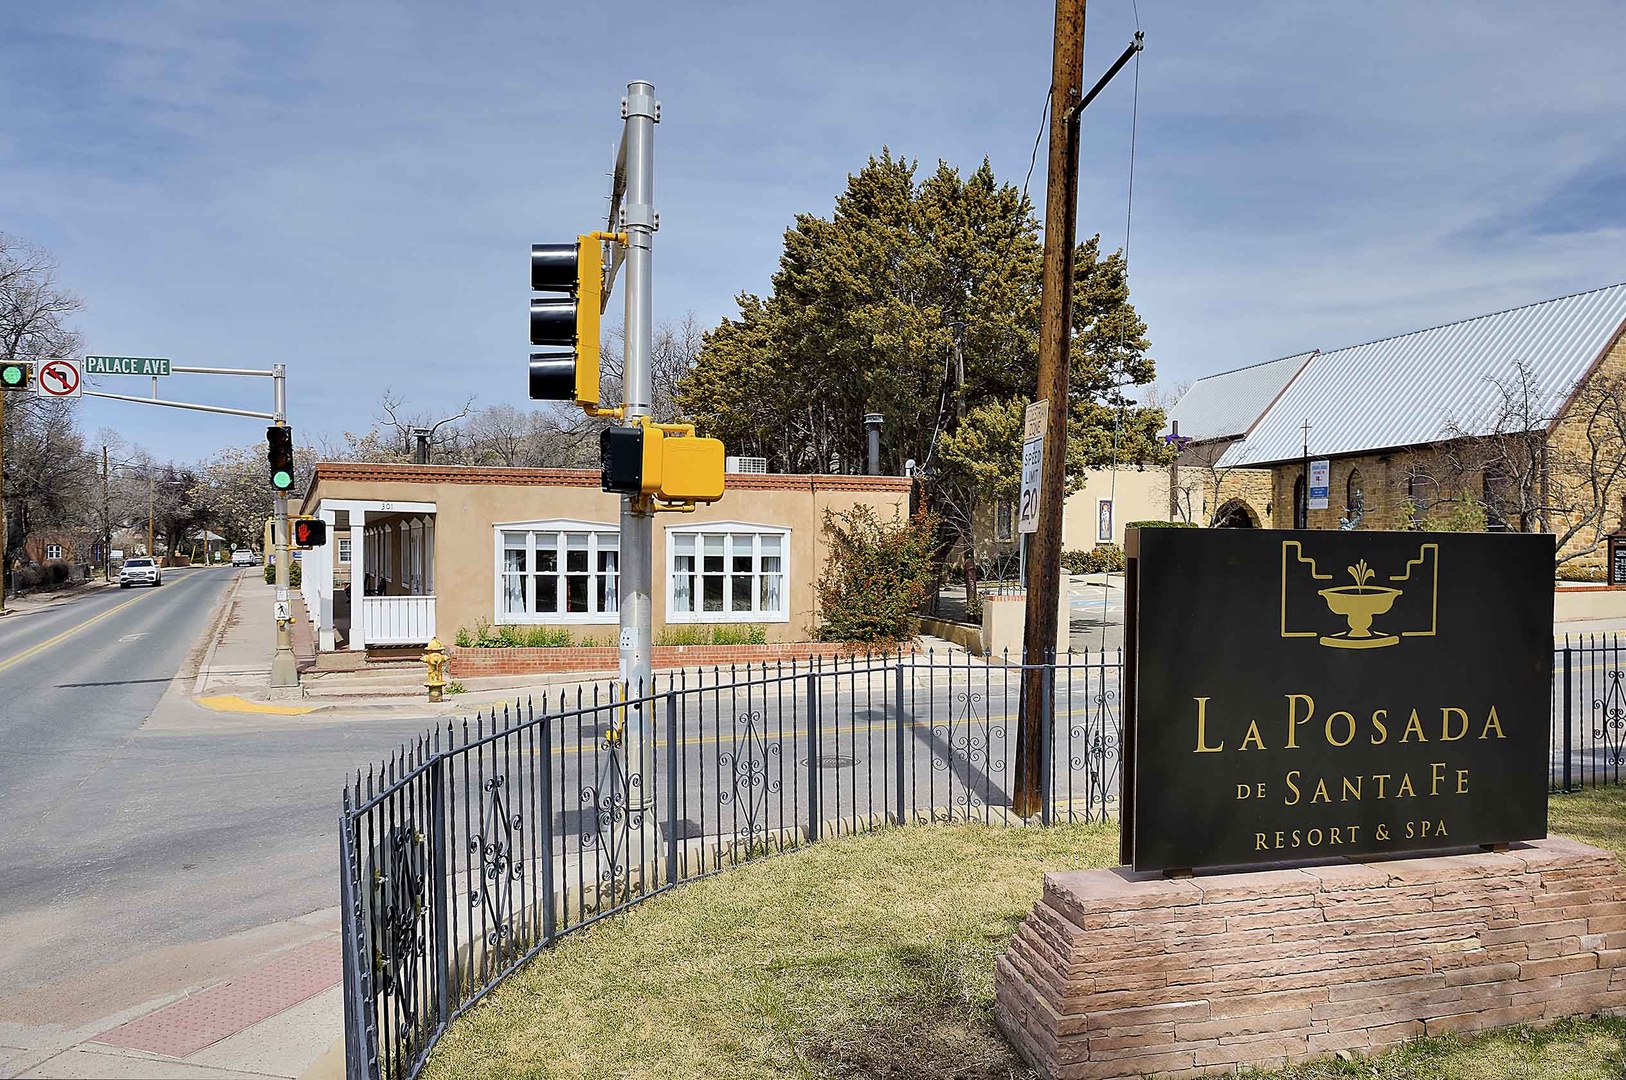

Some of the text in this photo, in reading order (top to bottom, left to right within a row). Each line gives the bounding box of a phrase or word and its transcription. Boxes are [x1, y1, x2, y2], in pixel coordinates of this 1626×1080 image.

[88, 358, 168, 375] PALACE AVE
[1029, 421, 1041, 437] ZONE
[1024, 450, 1041, 466] SPEED
[1025, 469, 1039, 485] LIMIT
[381, 503, 394, 511] 301
[1022, 487, 1038, 521] 20
[1193, 694, 1507, 753] LA POSADA
[1236, 762, 1470, 806] DE SANTA FE
[1254, 819, 1449, 851] RESORT & SPA
